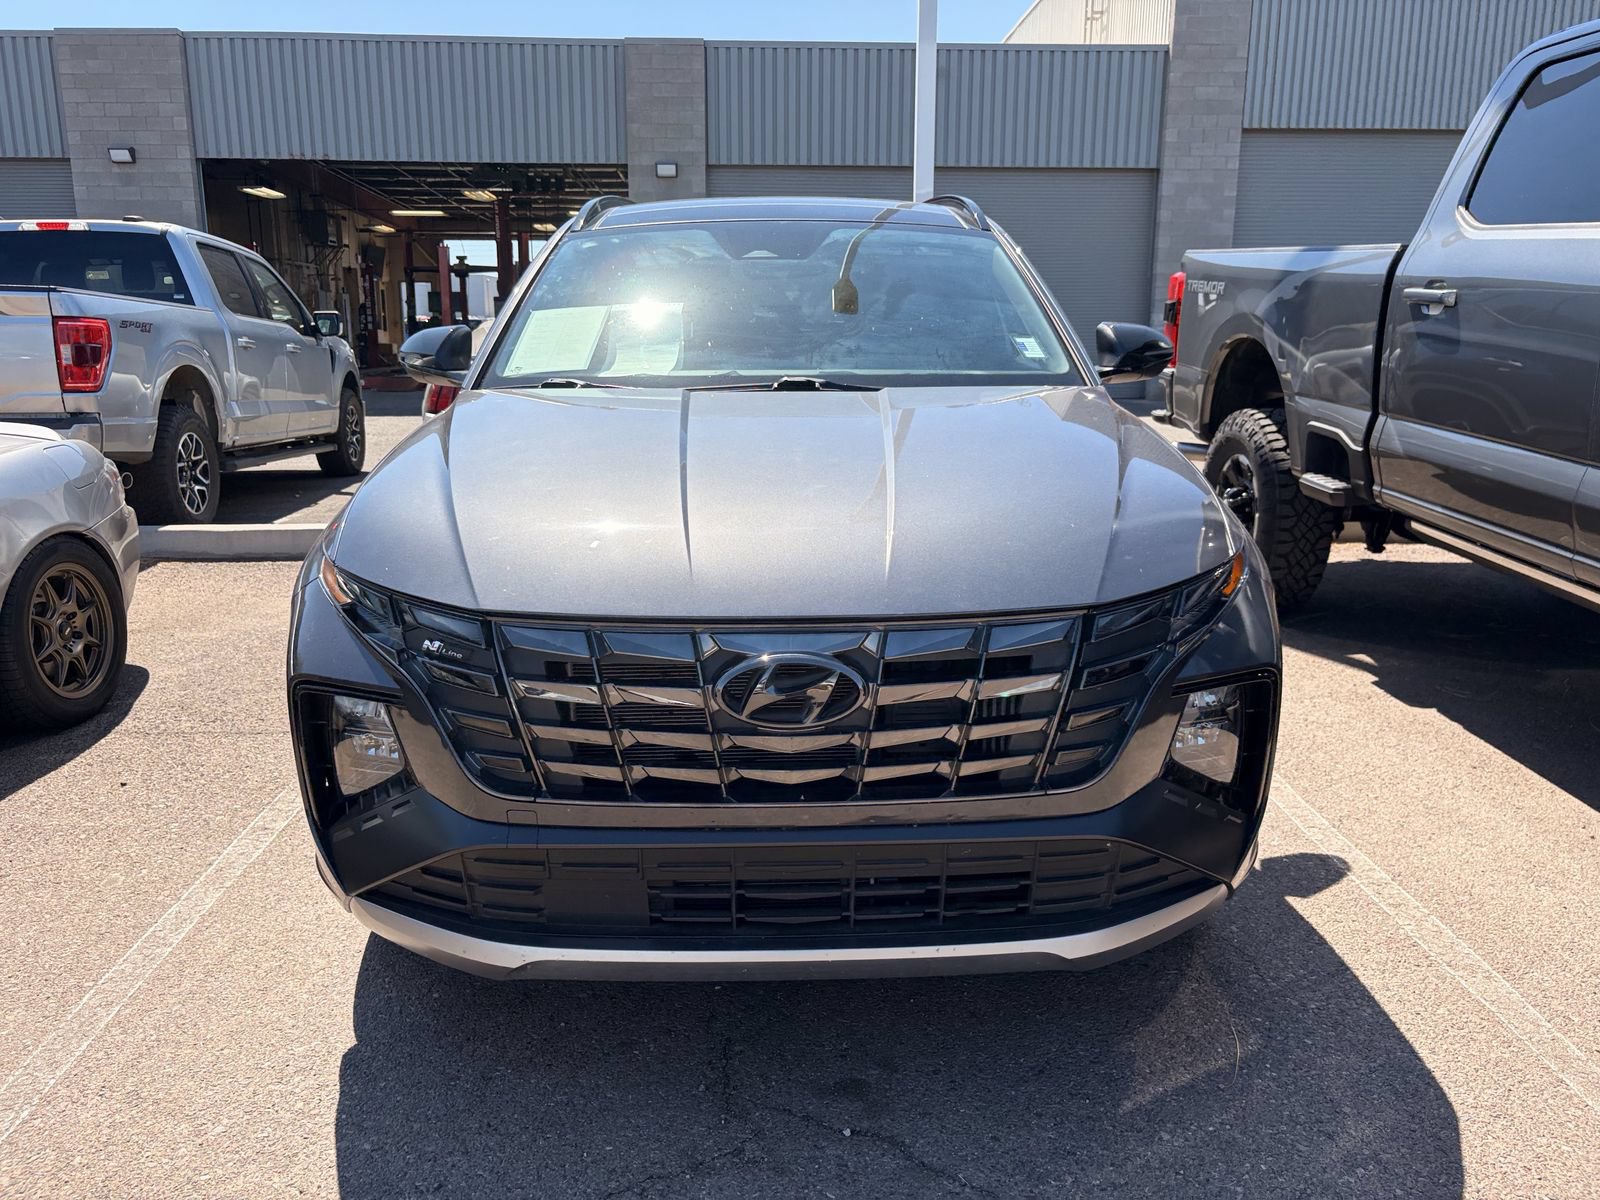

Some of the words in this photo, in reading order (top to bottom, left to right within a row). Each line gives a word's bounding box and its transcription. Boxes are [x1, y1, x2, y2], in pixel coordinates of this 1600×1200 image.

[1187, 280, 1225, 295] TREMOR
[119, 320, 153, 329] SPORT
[442, 648, 463, 660] Line
